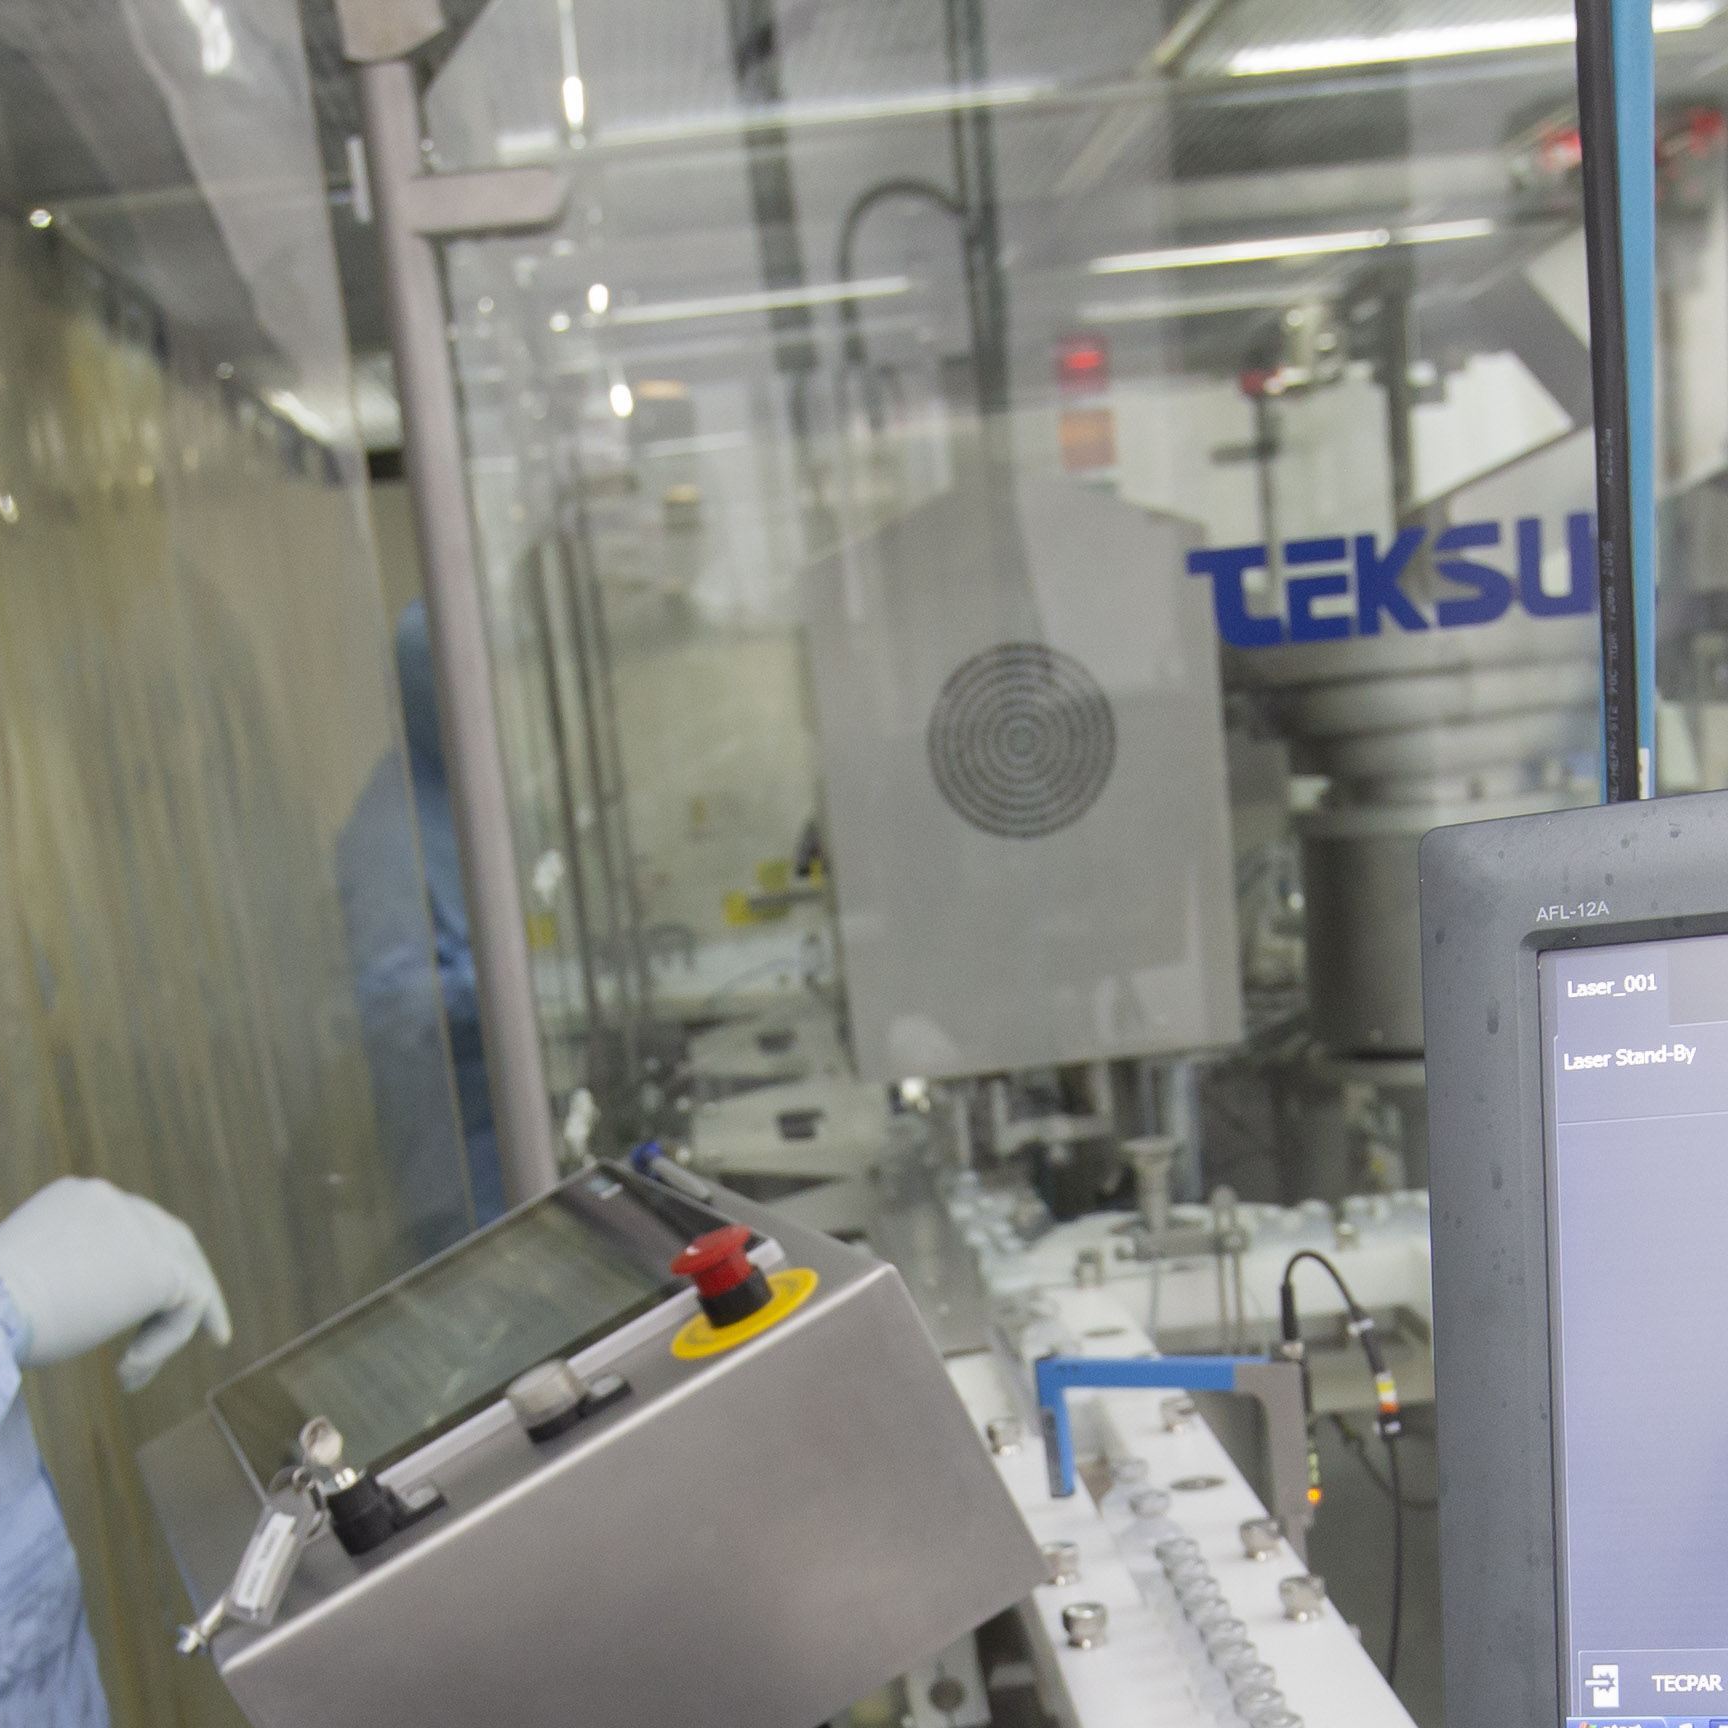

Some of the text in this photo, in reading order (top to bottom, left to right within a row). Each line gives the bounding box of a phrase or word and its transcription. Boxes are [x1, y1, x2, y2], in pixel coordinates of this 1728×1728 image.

[1536, 901, 1610, 922] AFL-12A
[1567, 974, 1658, 998] Laser_001
[1563, 1044, 1697, 1071] Laser Stand-By
[1651, 1674, 1724, 1692] TECPAR
